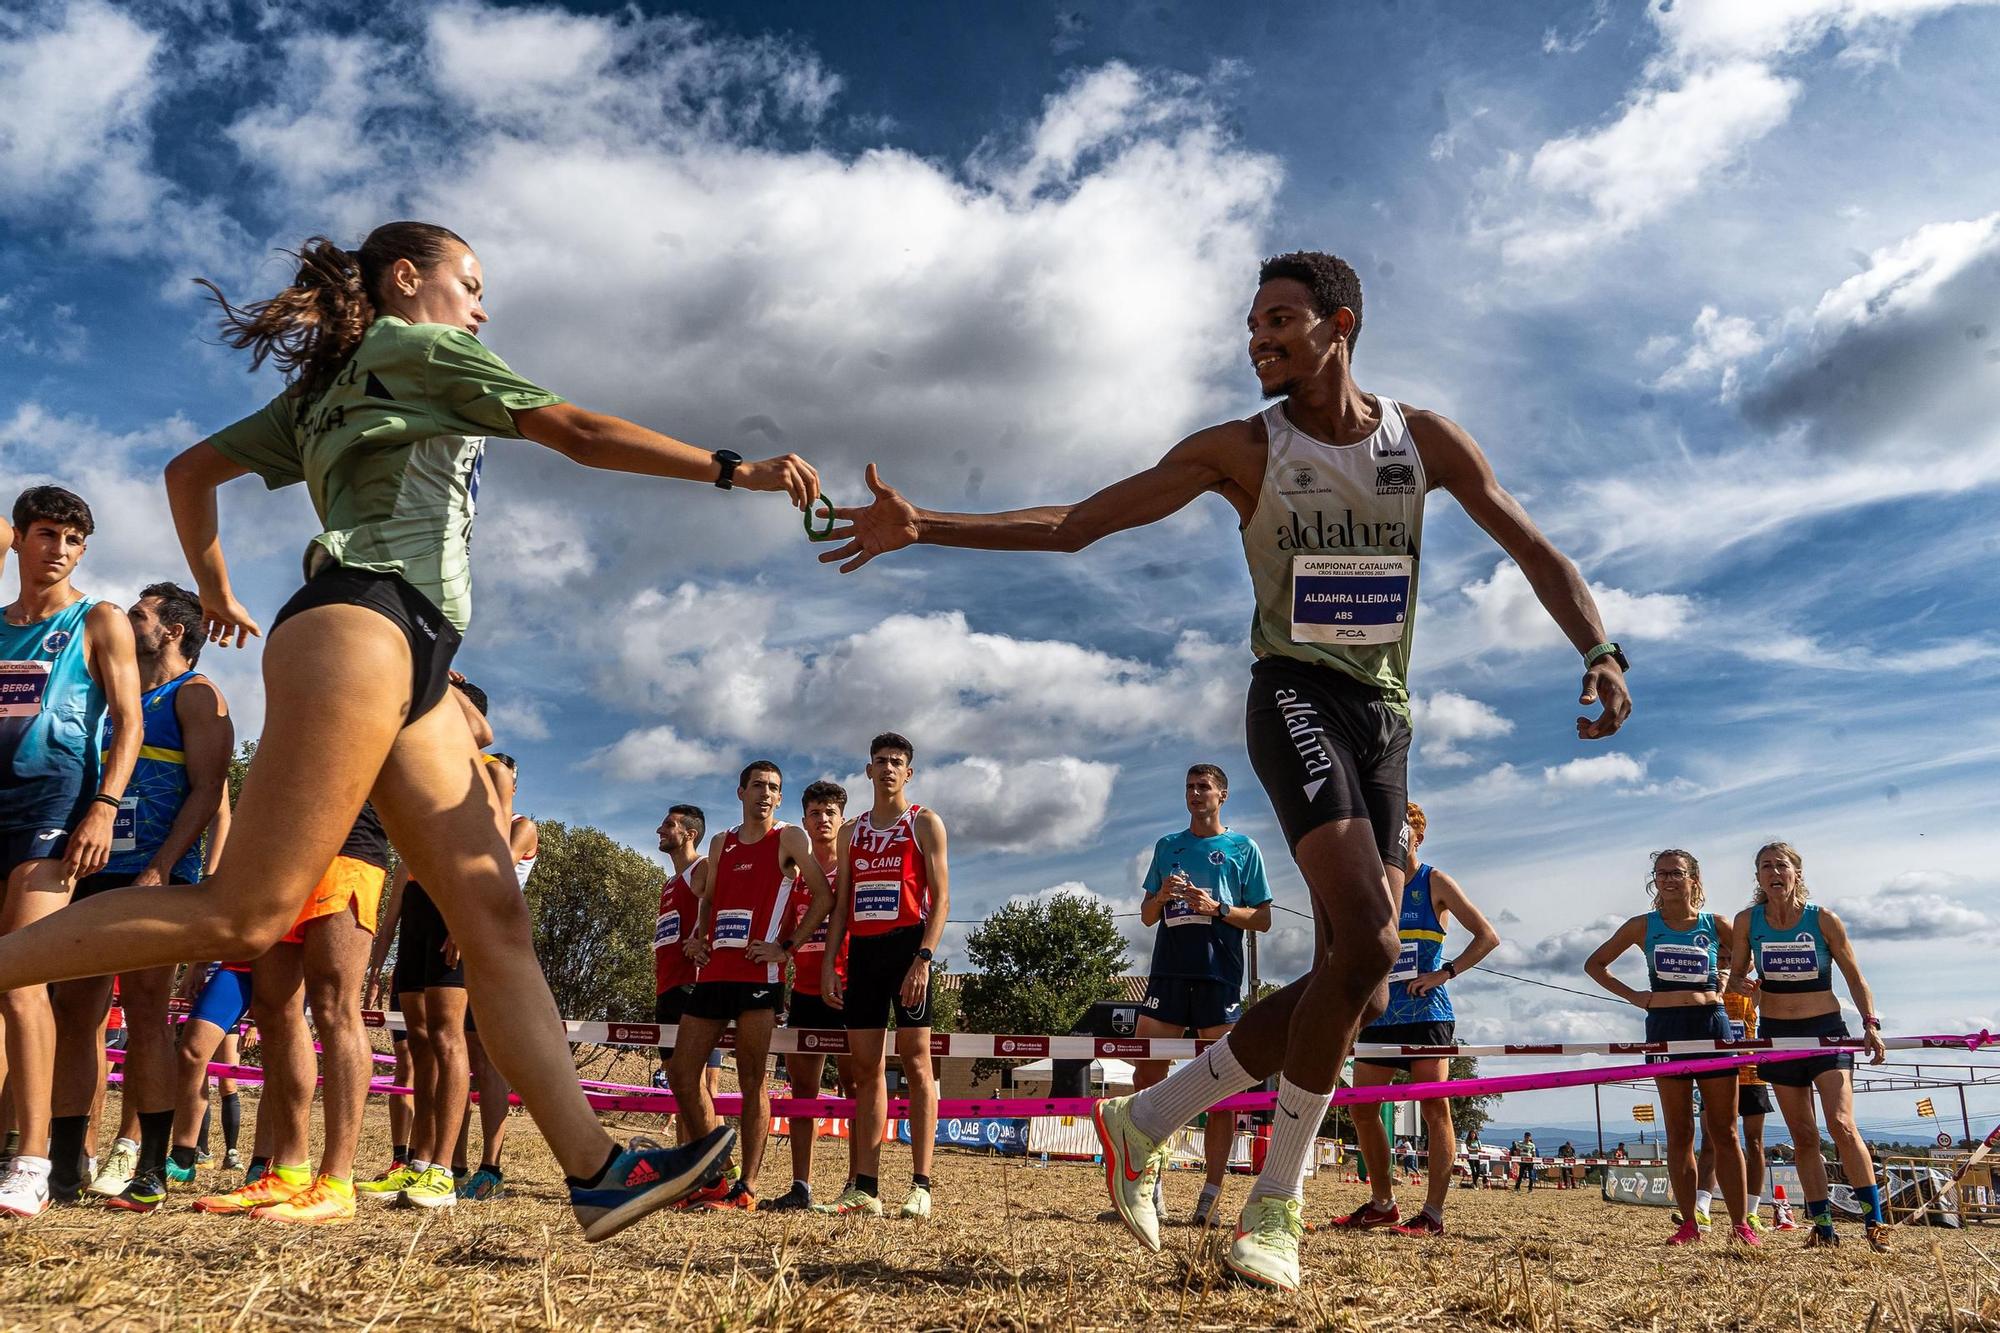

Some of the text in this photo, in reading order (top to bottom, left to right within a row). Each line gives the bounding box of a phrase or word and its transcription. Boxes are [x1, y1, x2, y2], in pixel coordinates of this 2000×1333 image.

[1376, 487, 1404, 496] LLEIDA
[1277, 509, 1407, 551] aldahra
[1304, 562, 1403, 570] CAMPIONAT CATALUNYA
[1304, 593, 1402, 604] ALDAHRA LLEIDA UA
[1334, 611, 1353, 620] ABS
[1335, 629, 1367, 638] FCA
[1275, 688, 1332, 777] aldahra
[870, 855, 902, 870] CANB
[1395, 957, 1415, 965] VELLES
[1661, 958, 1703, 968] JAB-BERGA
[1769, 957, 1812, 965] JAB-BERGA
[961, 1121, 980, 1136] JAB
[1000, 1125, 1016, 1139] JAB
[625, 1171, 661, 1188] adidas
